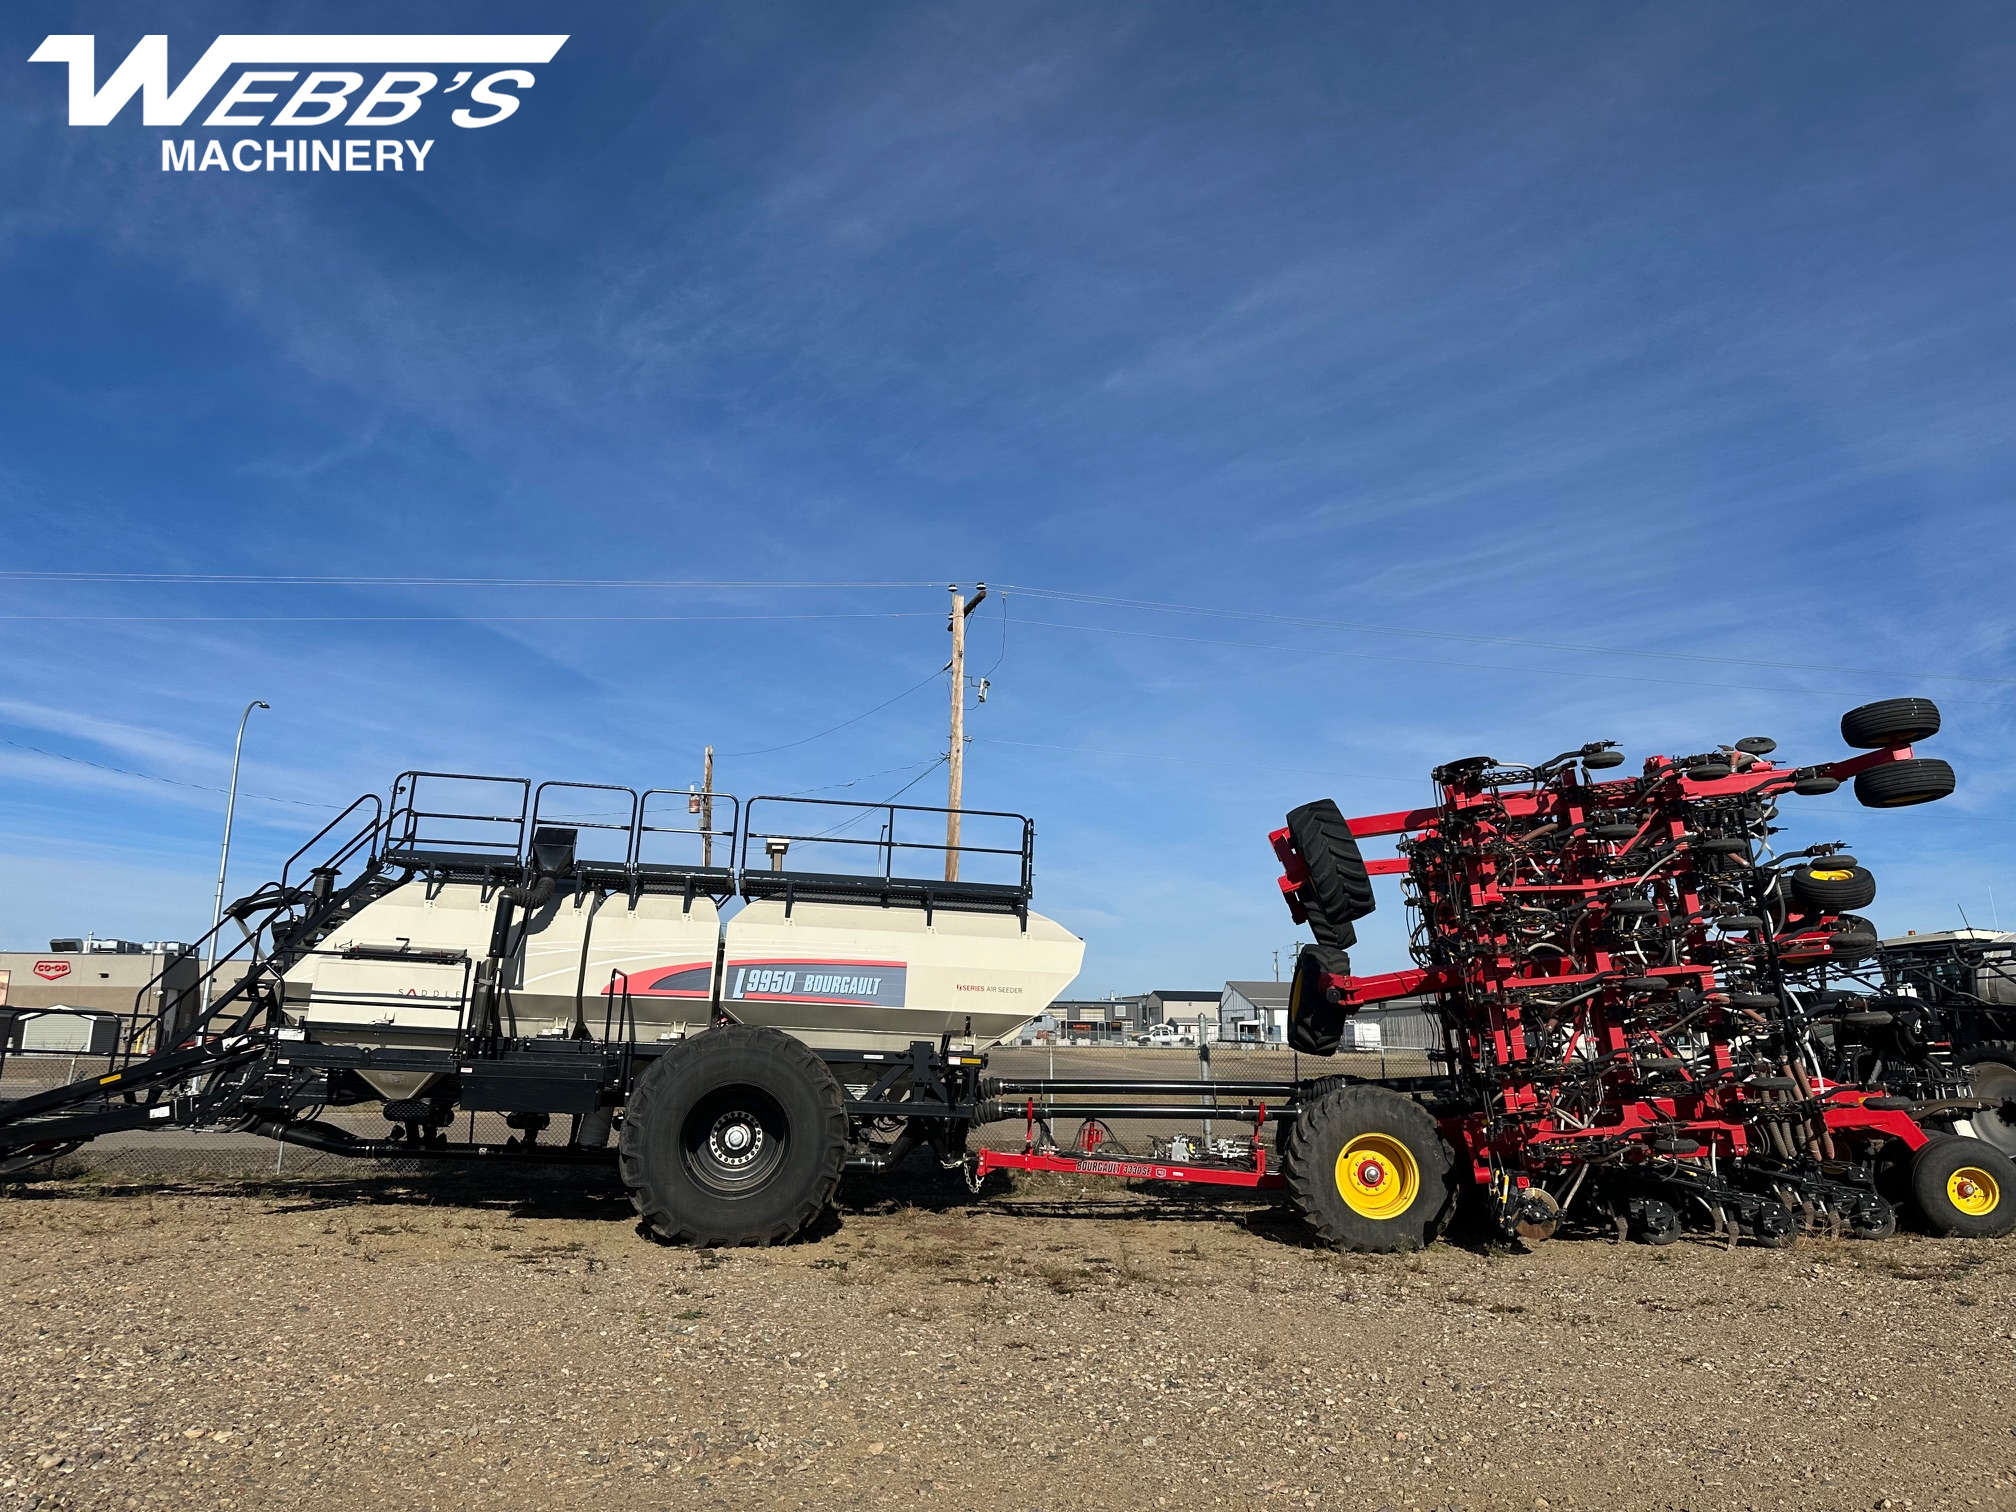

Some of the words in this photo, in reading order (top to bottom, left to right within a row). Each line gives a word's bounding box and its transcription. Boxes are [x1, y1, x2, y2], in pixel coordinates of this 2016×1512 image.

[803, 974, 882, 996] BOURGAULT
[398, 988, 461, 998] SADDLE
[1077, 1161, 1121, 1174] BOURGAULT
